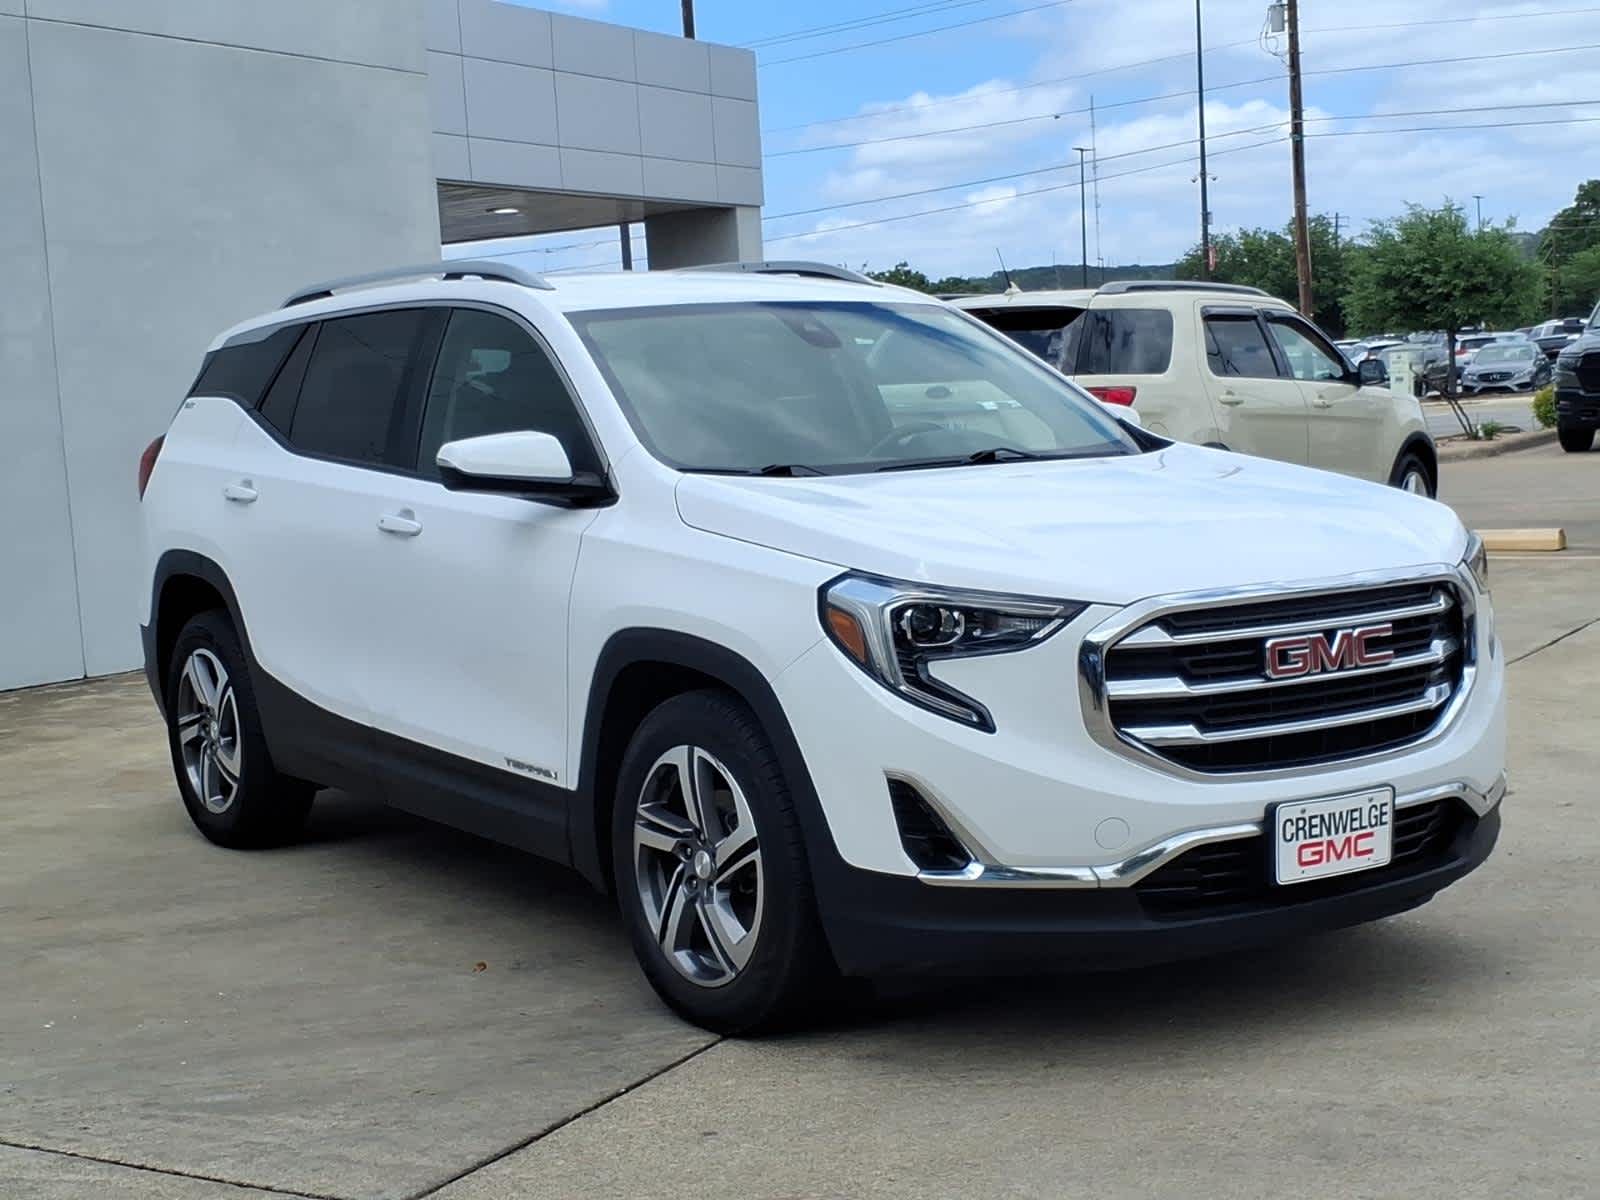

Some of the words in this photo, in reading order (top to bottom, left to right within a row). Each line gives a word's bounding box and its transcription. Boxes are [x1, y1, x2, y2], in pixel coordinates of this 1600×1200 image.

[1265, 624, 1394, 678] GMC
[1282, 802, 1388, 843] CRENWELGE
[1298, 831, 1374, 867] GMC
